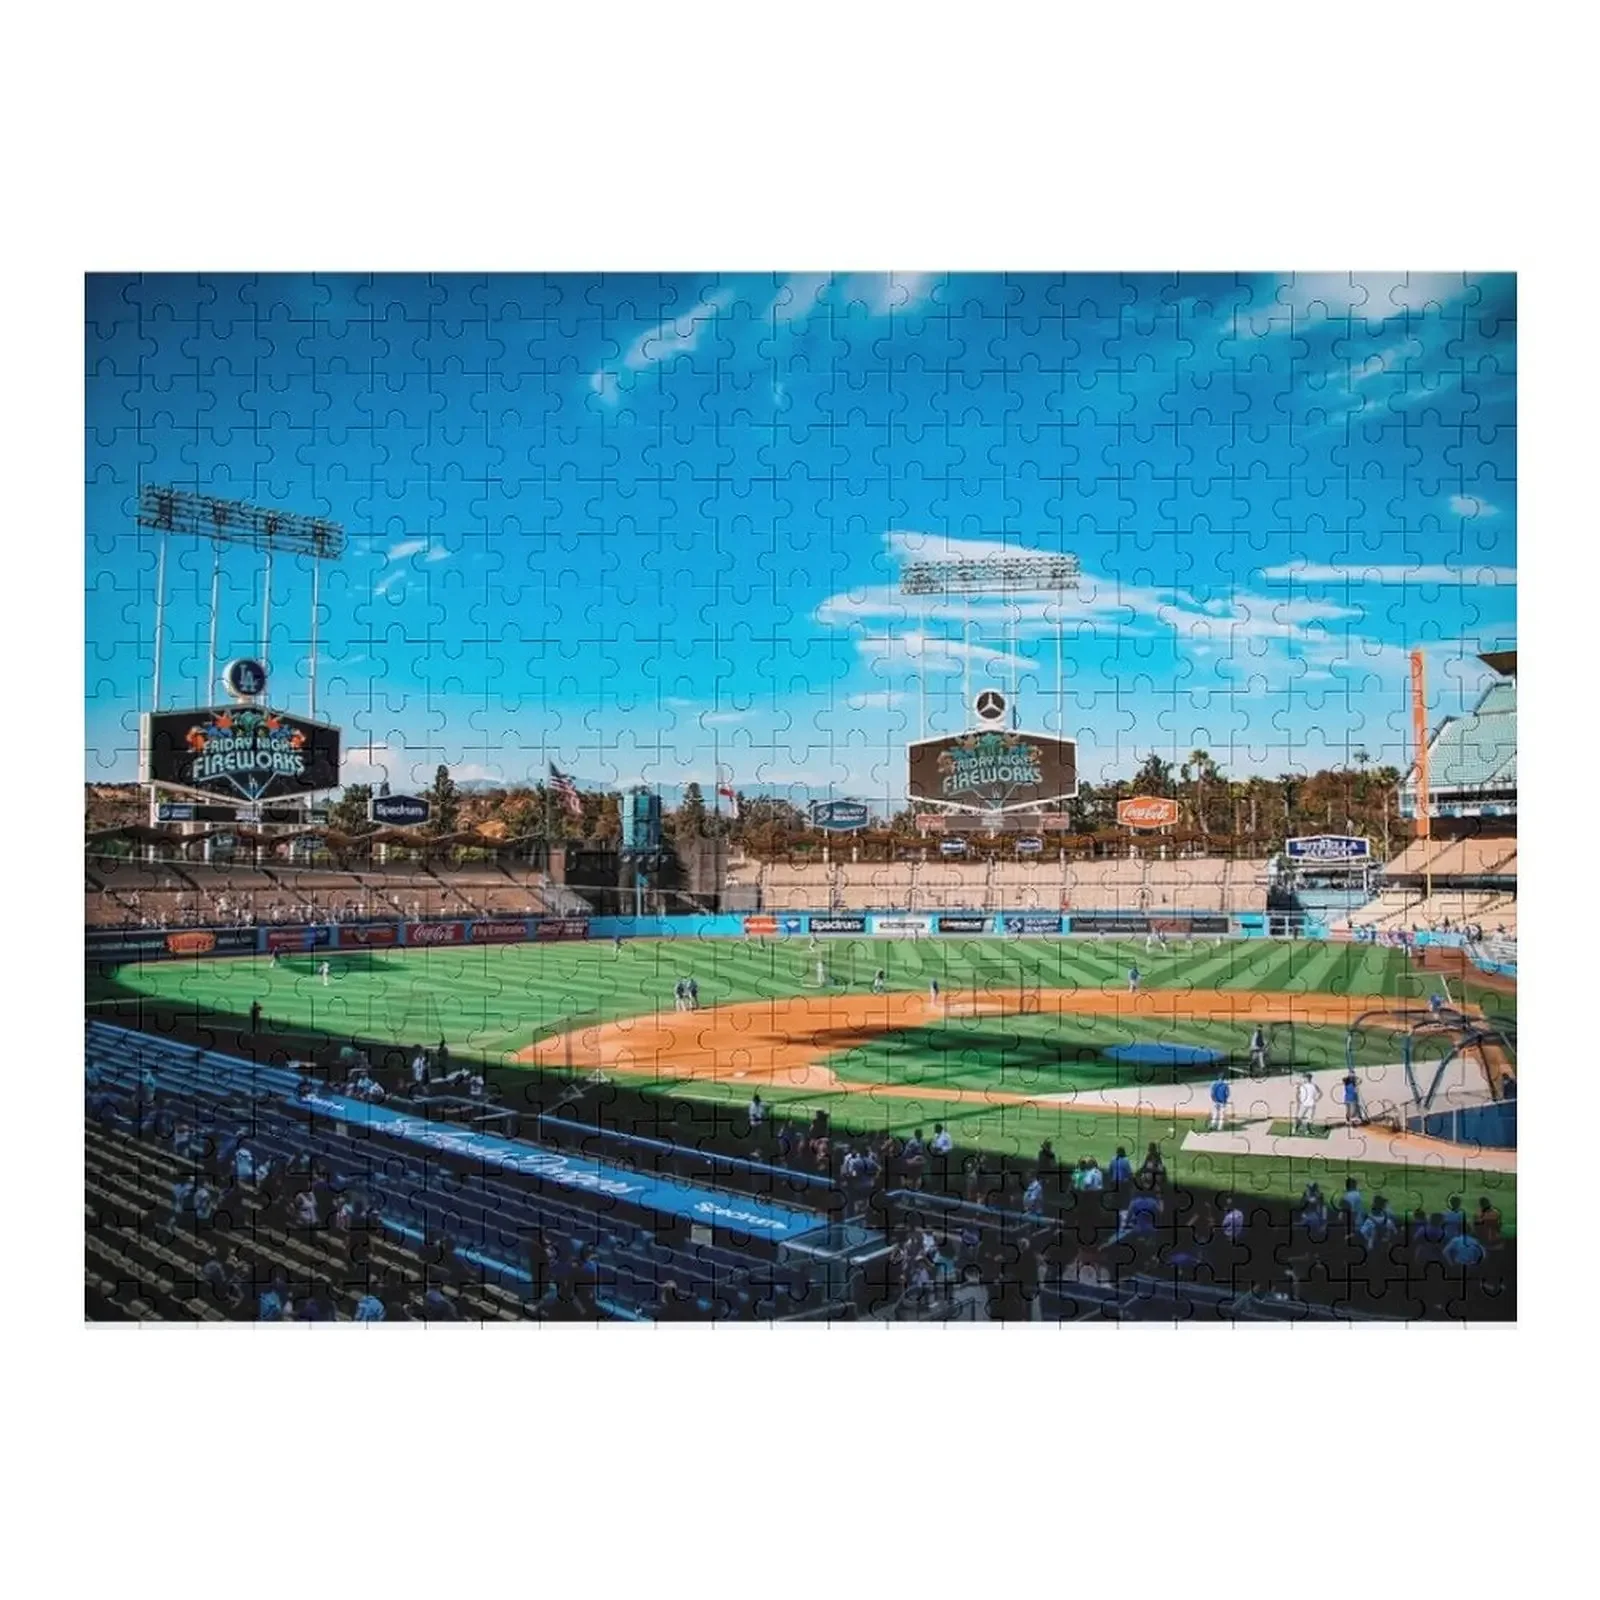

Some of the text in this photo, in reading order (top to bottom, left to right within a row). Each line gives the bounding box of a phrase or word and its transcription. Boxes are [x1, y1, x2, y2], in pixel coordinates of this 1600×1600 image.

[203, 737, 254, 754] FRIDAY
[192, 750, 305, 782] FIREWORKS
[941, 766, 1044, 796] FIREWORKS
